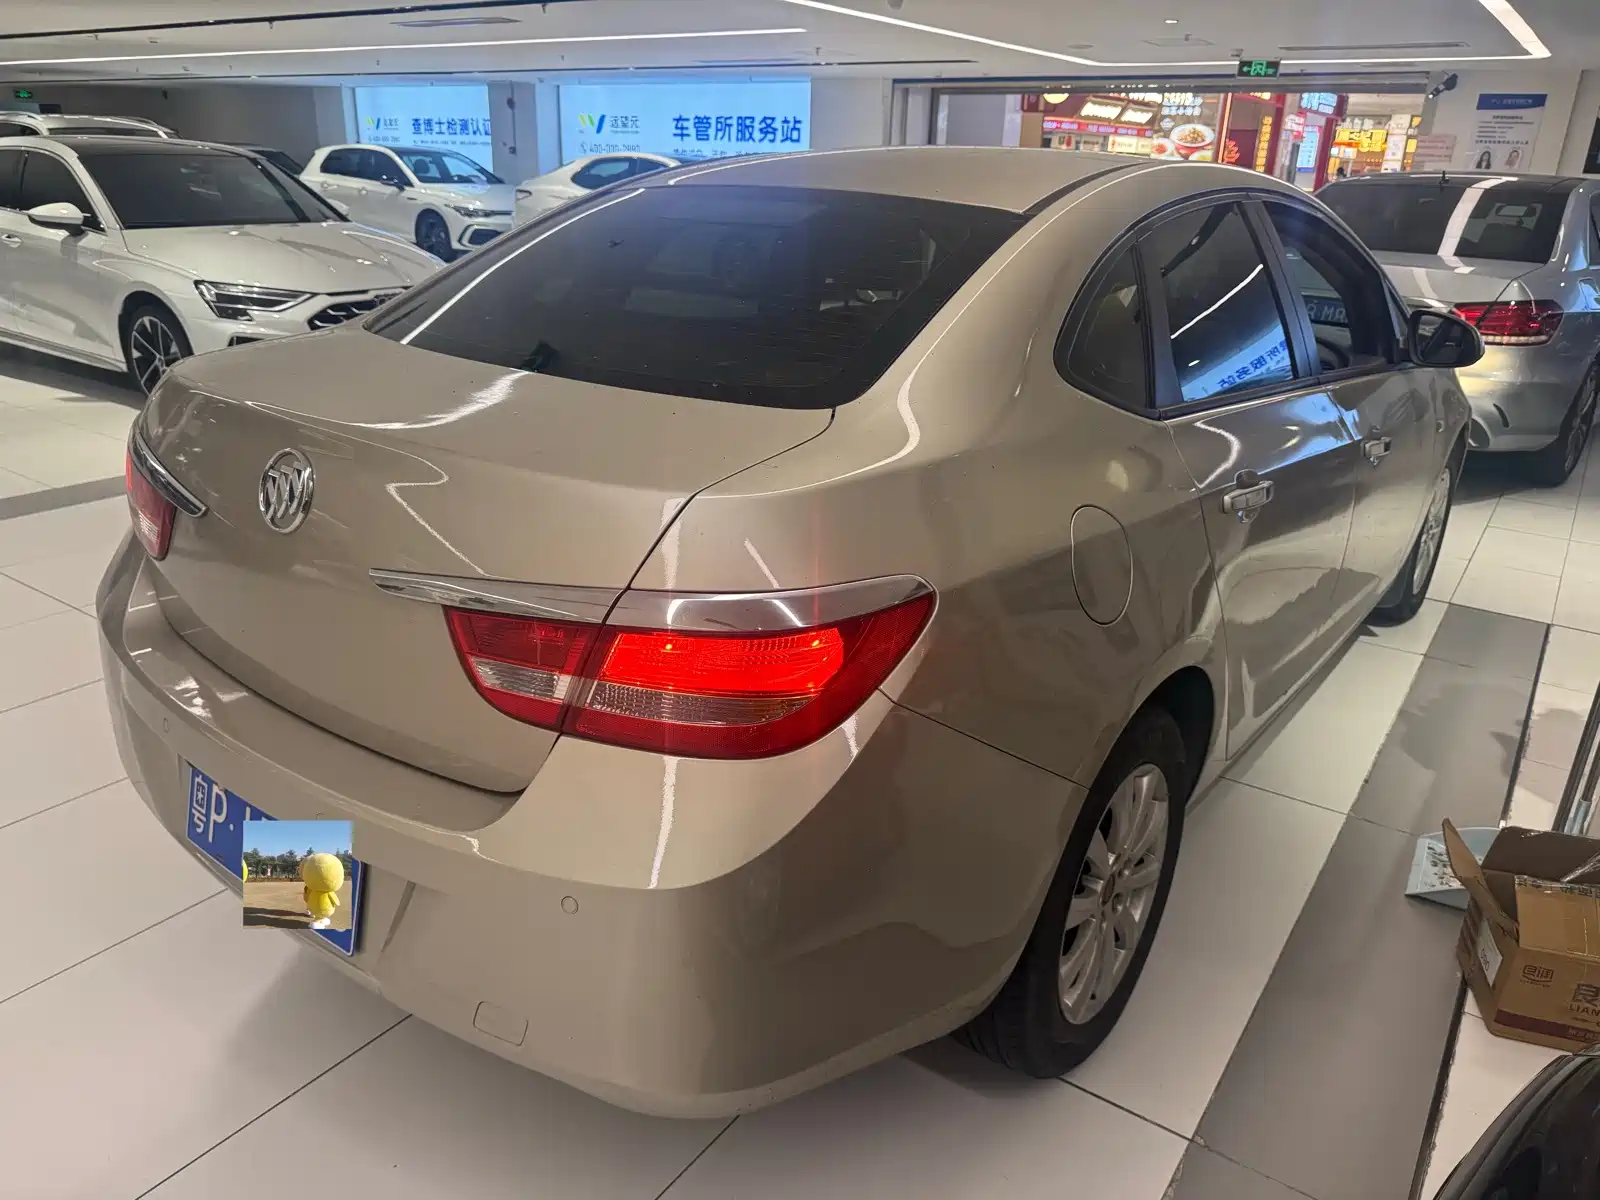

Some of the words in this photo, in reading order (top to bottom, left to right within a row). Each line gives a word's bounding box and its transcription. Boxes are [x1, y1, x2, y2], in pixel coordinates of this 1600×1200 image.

[412, 117, 491, 136] 查博士检测认证
[672, 115, 802, 143] 车管所服务站
